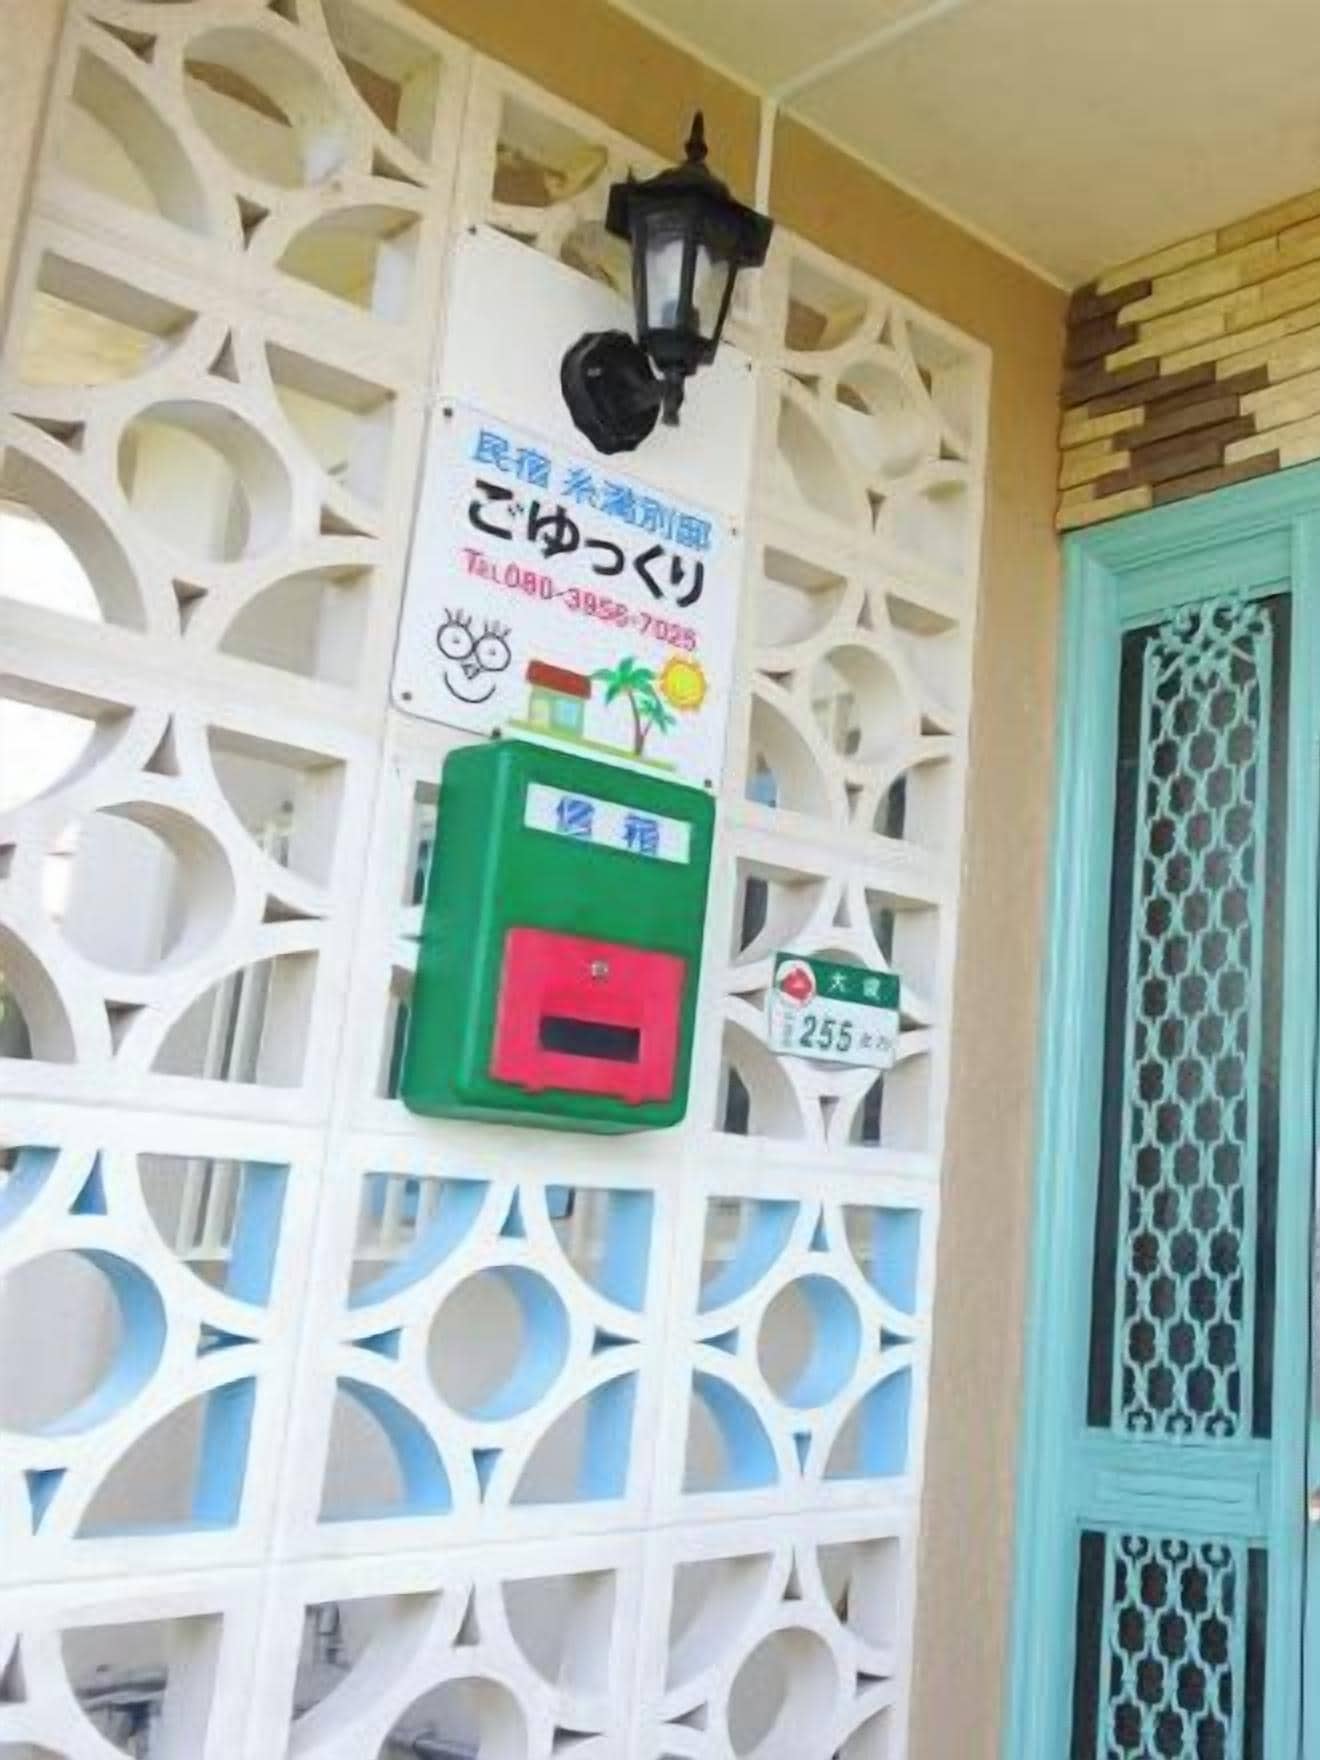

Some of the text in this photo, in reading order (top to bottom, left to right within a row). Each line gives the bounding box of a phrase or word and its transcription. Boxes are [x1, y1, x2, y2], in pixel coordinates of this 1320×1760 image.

[467, 478, 704, 608] ごゆっくり
[799, 1015, 853, 1052] 255
